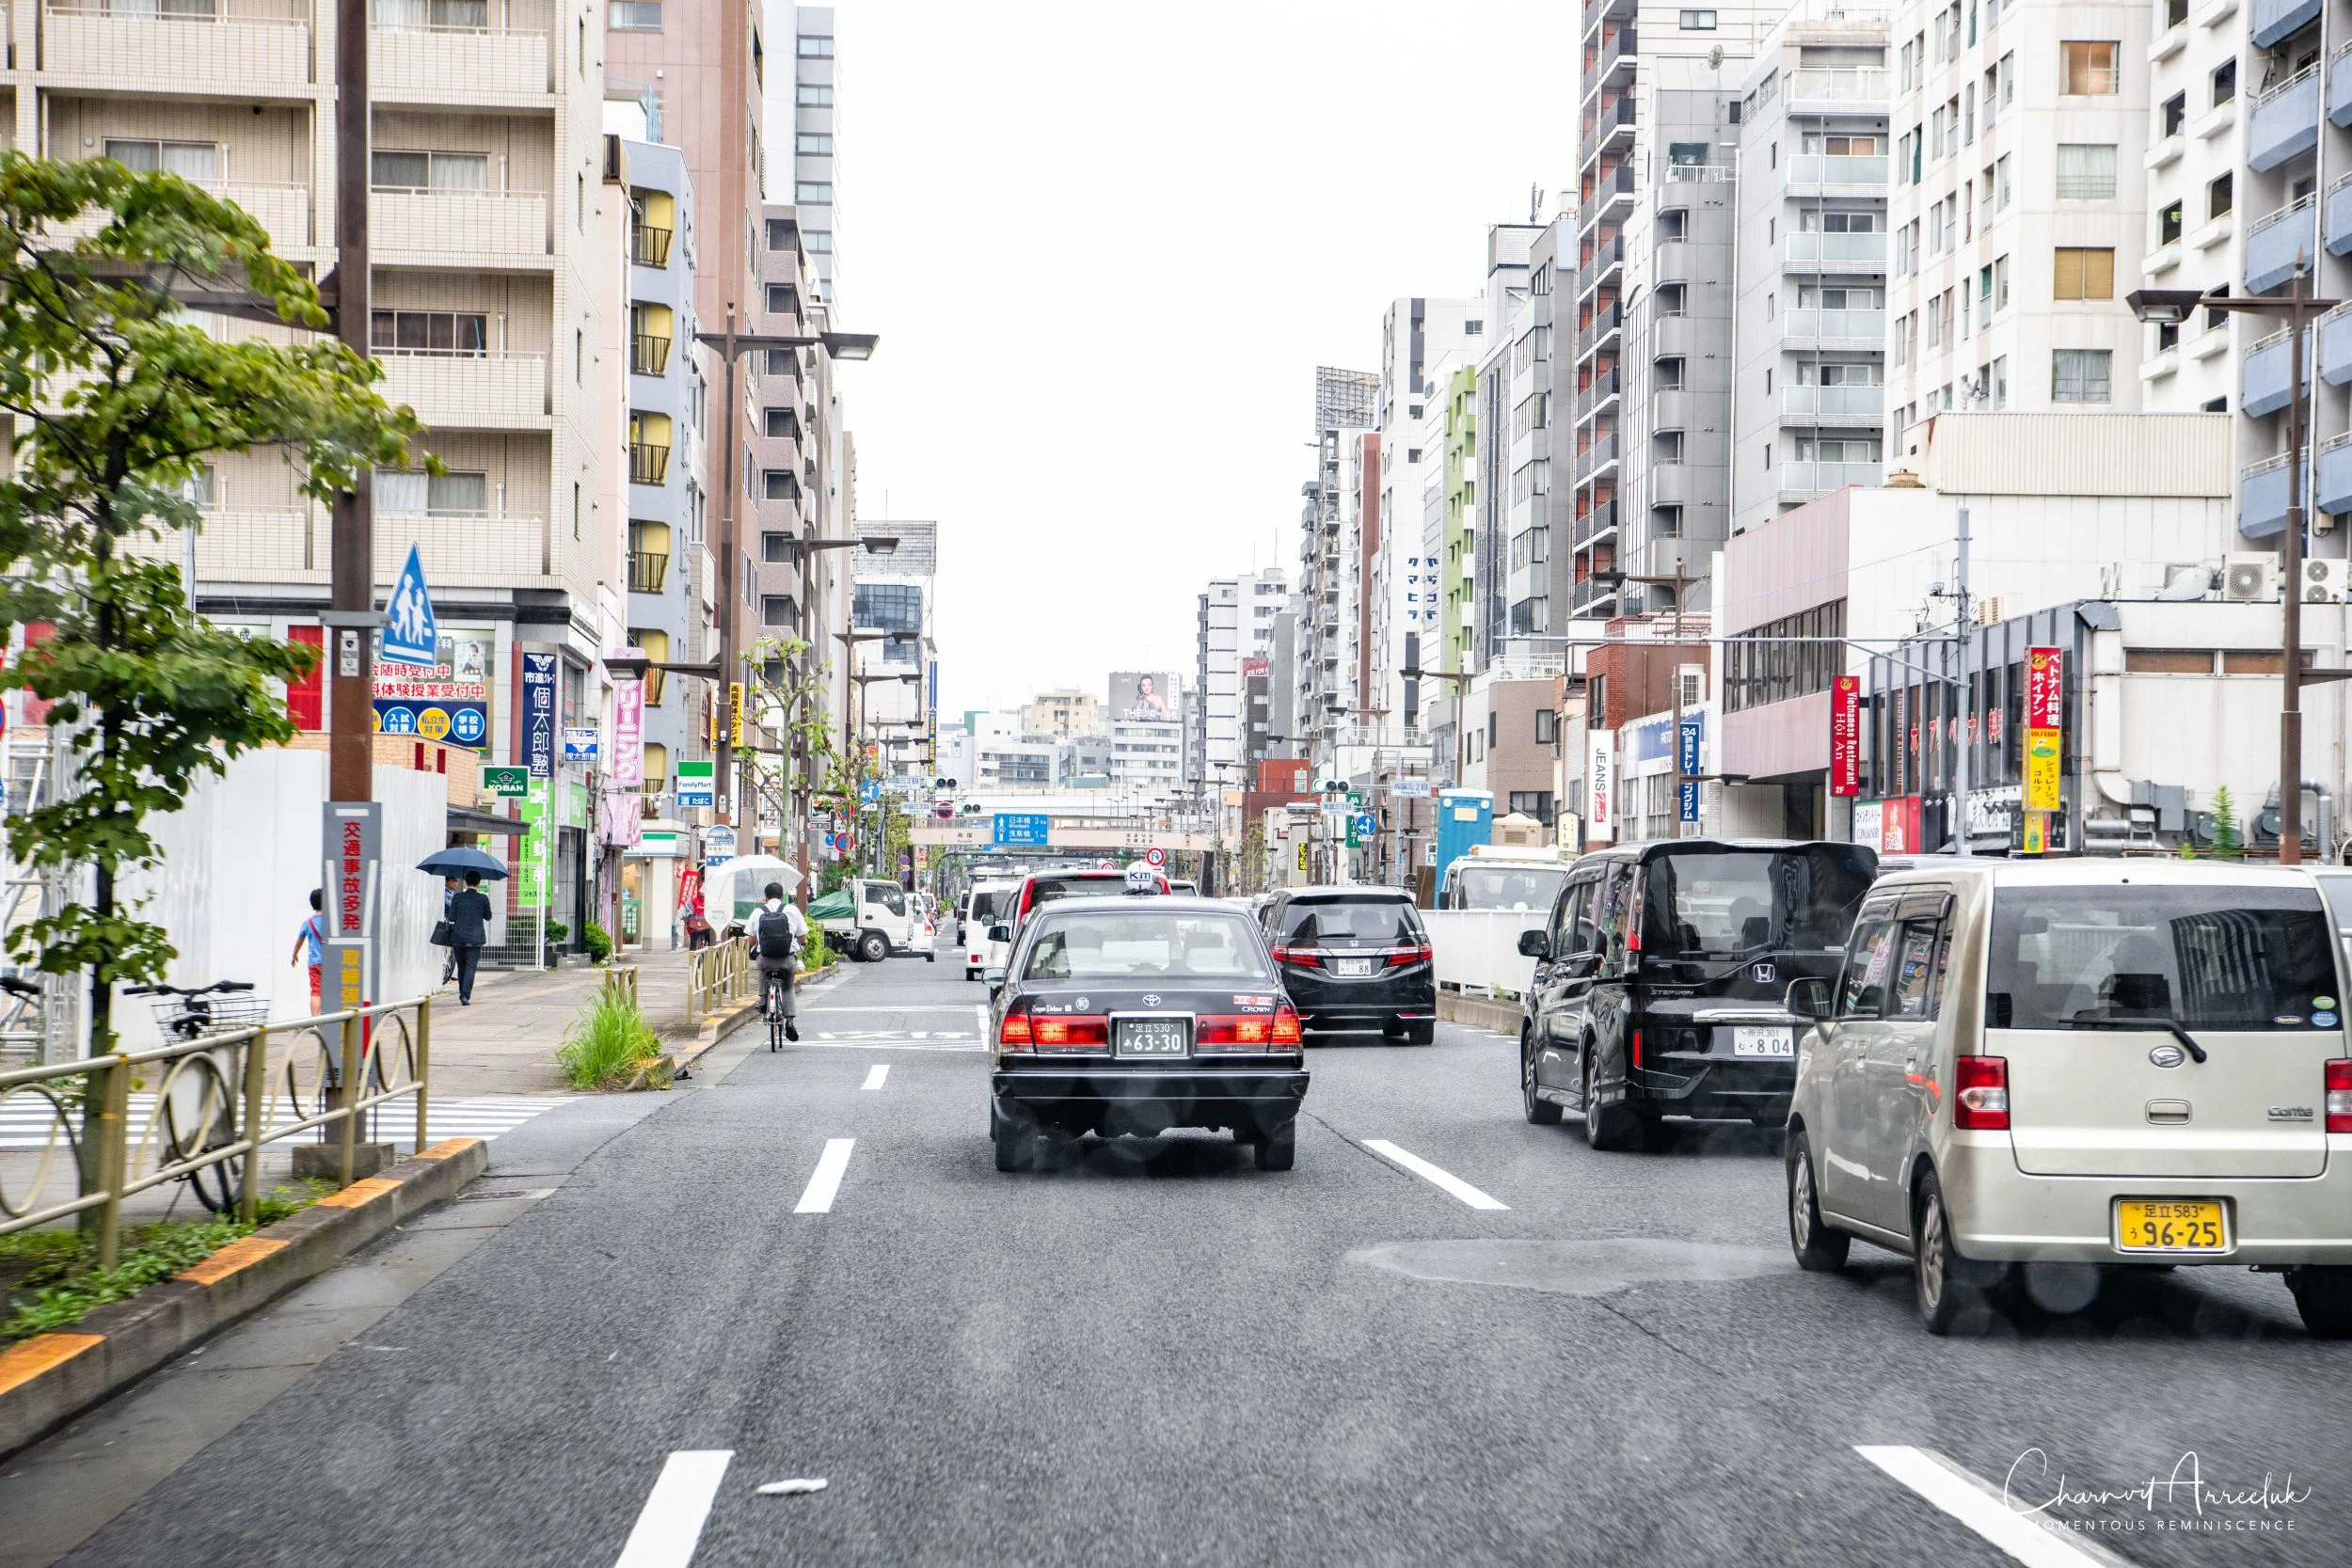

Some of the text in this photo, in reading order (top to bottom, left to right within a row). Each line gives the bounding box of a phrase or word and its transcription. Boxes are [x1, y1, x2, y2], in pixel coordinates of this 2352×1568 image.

[2032, 672, 2045, 716] ホイアン
[2046, 653, 2060, 726] ベトナム料理
[531, 686, 550, 775] 個太郎塾
[1846, 691, 1857, 785] Vietnamese Restaurant
[1836, 741, 1845, 760] An
[1595, 748, 1607, 791] JEANS
[1836, 785, 1845, 794] 2F
[691, 797, 709, 805] たばこ
[342, 821, 361, 930] 交通事故多発
[1135, 1023, 1170, 1033] 足立 530
[1748, 1028, 1780, 1037] 所沢 301
[1134, 1034, 1181, 1051] 63-30
[2267, 1105, 2313, 1117] Conte
[2144, 1204, 2200, 1218] 足立 583
[2130, 1222, 2217, 1246] う 96-25
